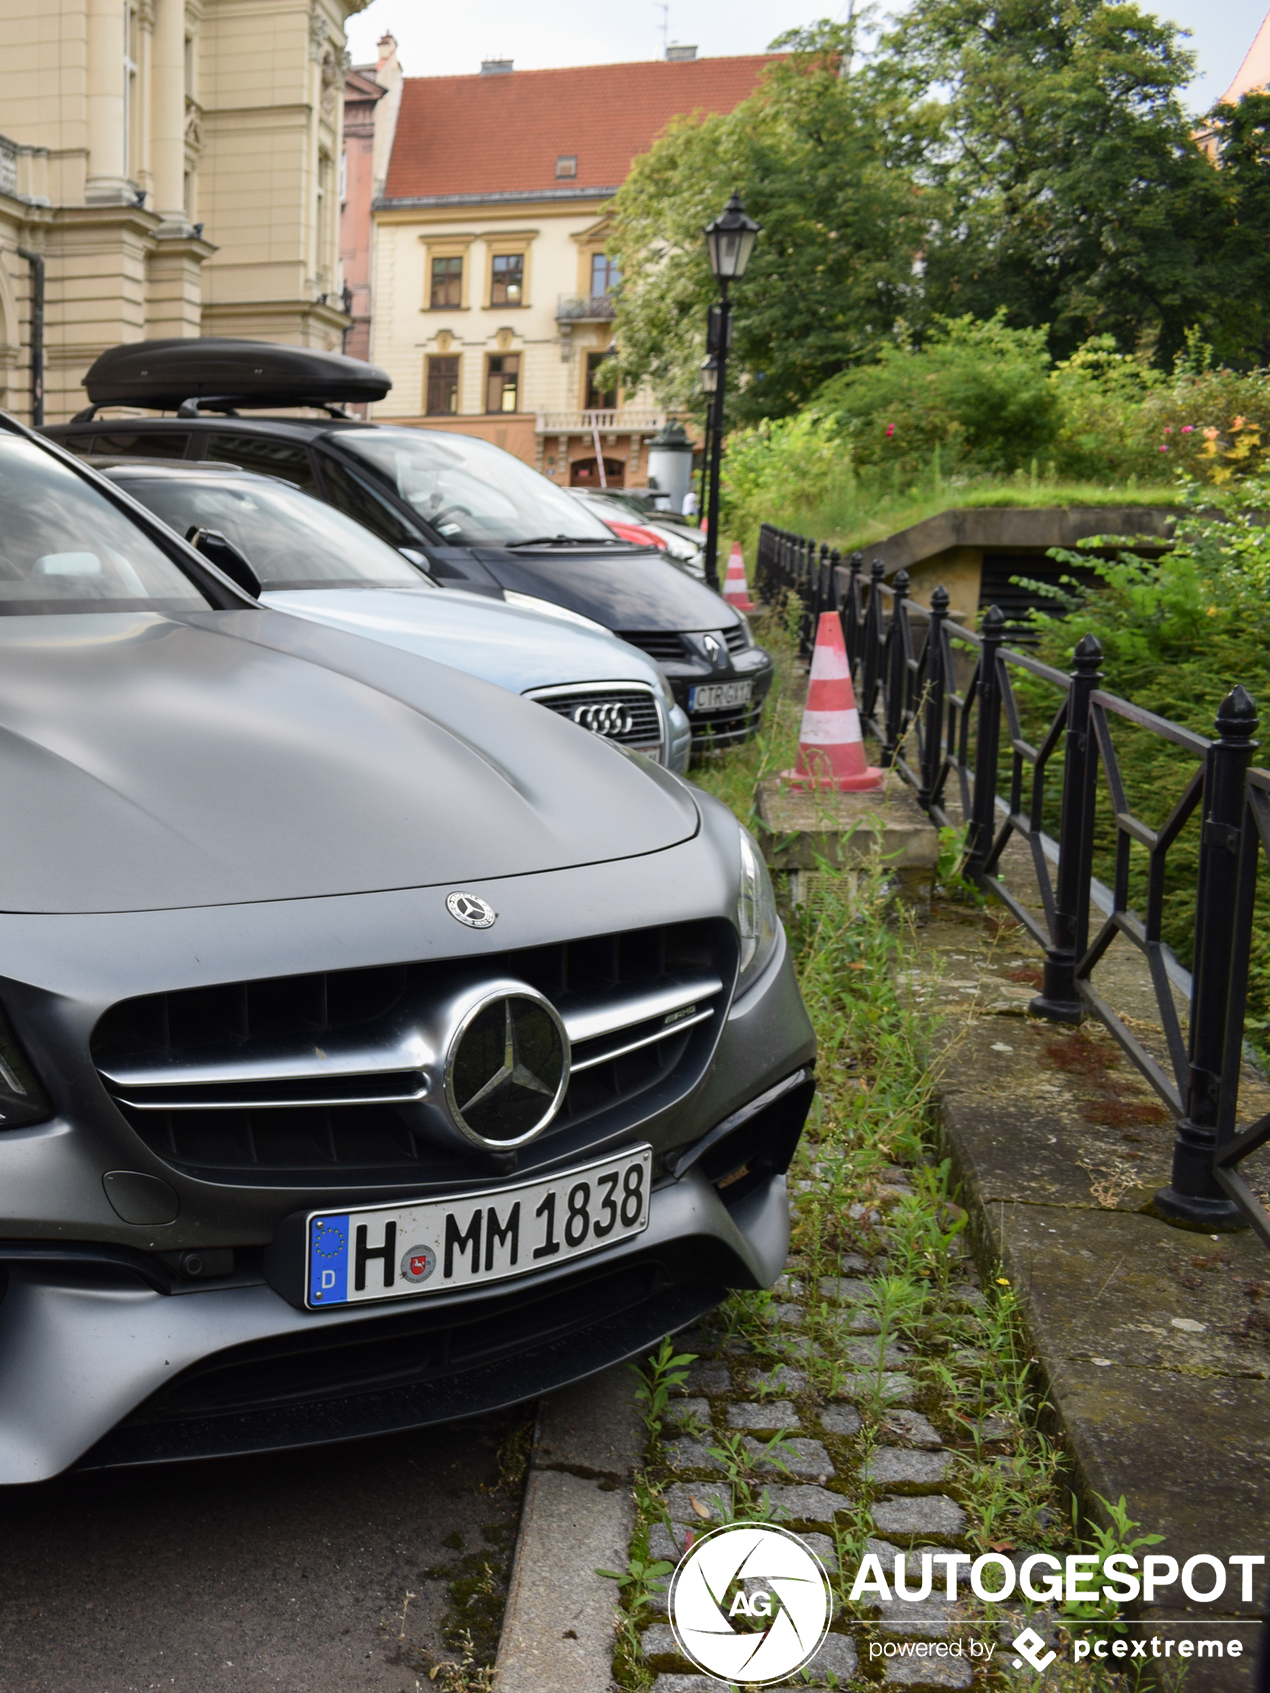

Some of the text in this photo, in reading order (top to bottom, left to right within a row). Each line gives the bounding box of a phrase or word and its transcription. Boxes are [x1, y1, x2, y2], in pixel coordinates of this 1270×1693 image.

[697, 685, 723, 707] CTR
[674, 1005, 696, 1020] AMG
[354, 1220, 397, 1292] H
[443, 1200, 521, 1279] MM
[532, 1162, 644, 1260] 1838
[321, 1269, 335, 1289] D
